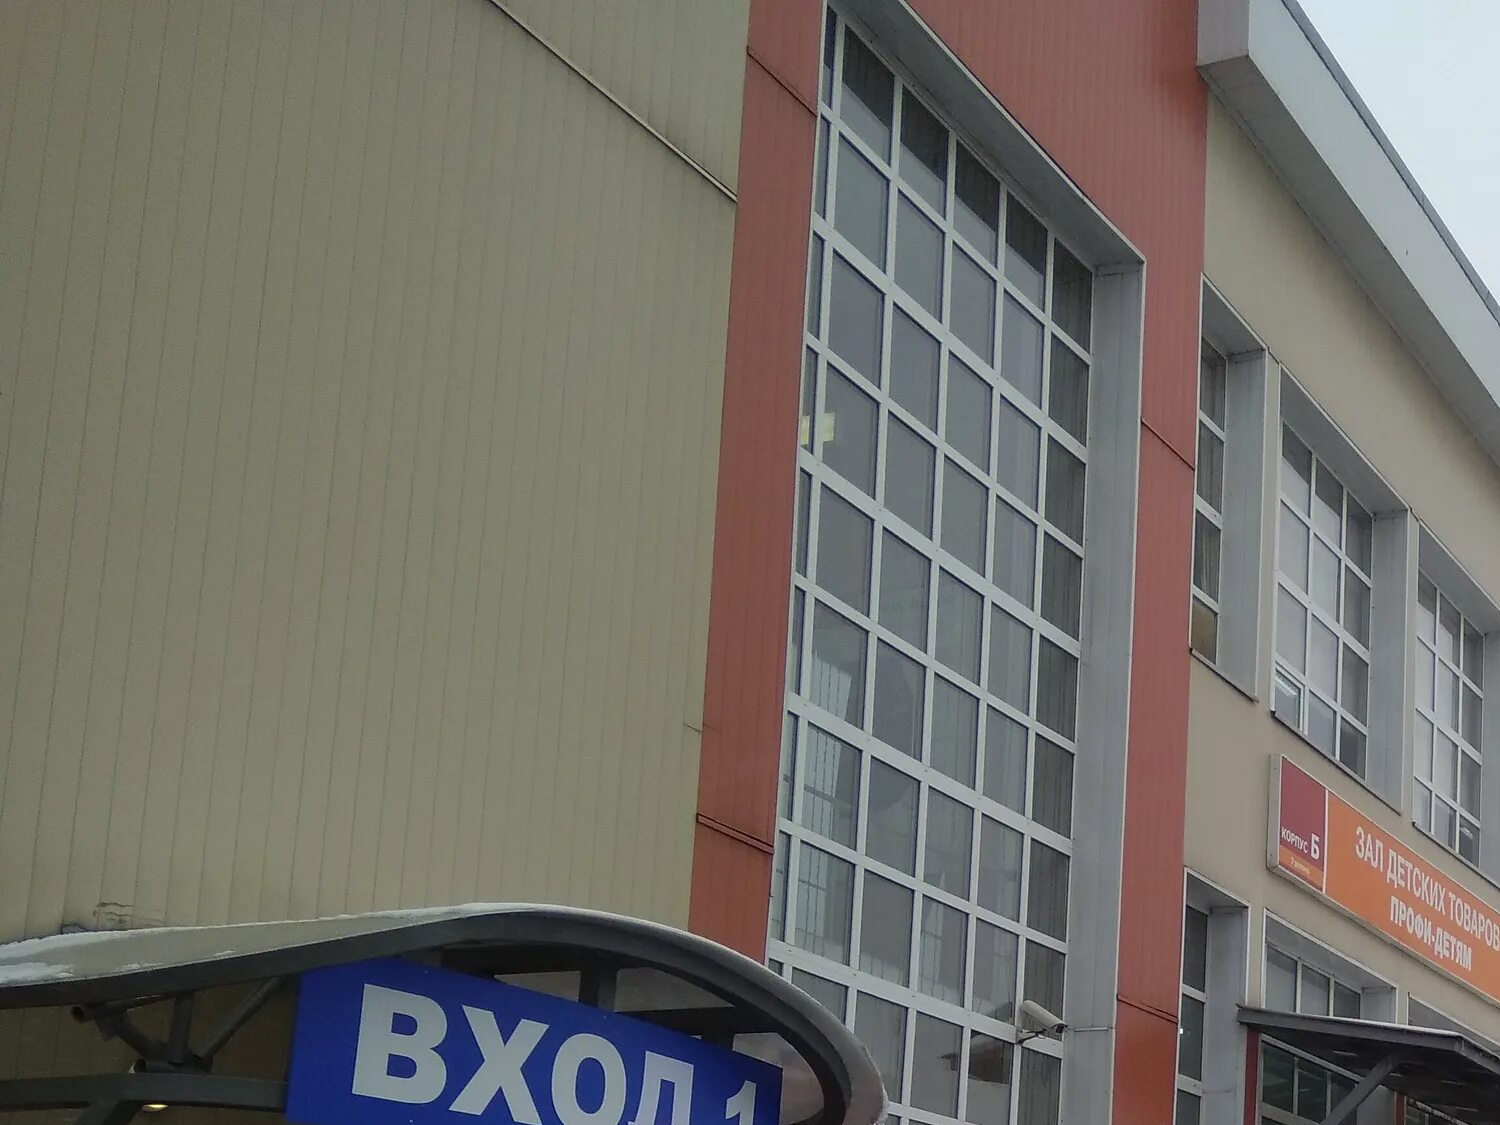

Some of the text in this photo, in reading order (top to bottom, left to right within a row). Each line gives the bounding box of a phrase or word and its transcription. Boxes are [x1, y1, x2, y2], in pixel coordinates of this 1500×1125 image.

[1281, 826, 1320, 860] КОРПУС Б
[1355, 826, 1500, 952] ЗАЛ ДЕТСКИХ ТОВАРОВ
[1389, 895, 1472, 972] ПРОФИ-ДЕТЯМ
